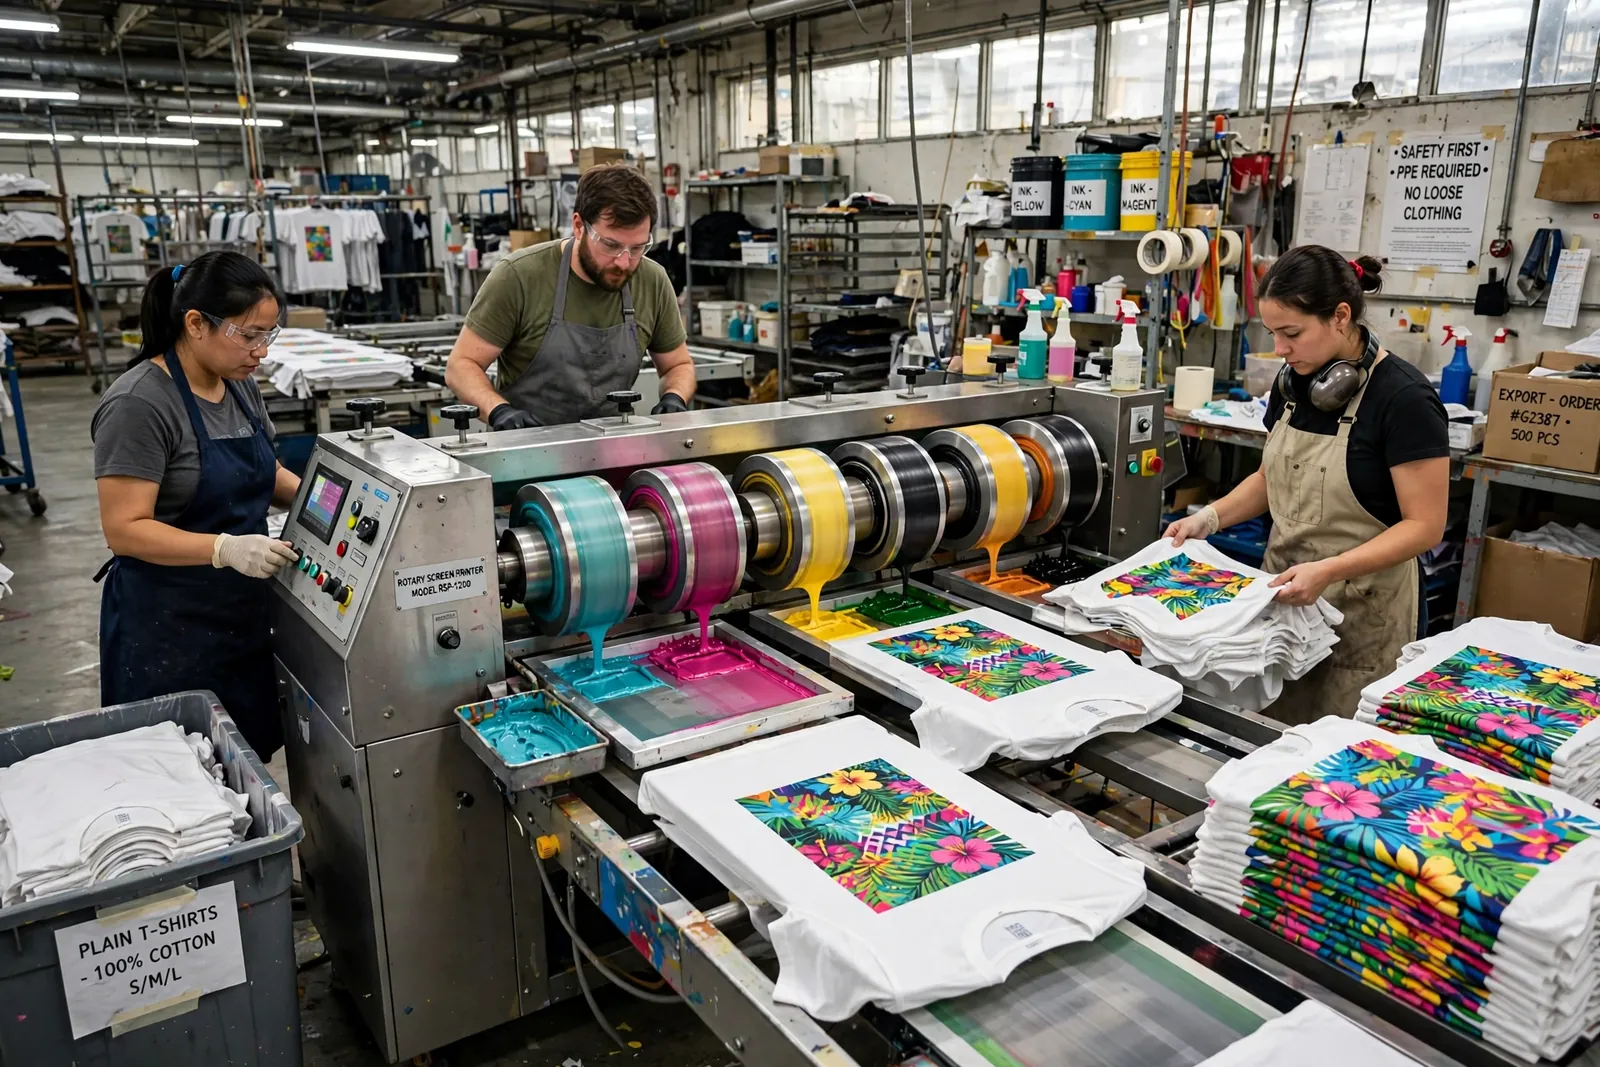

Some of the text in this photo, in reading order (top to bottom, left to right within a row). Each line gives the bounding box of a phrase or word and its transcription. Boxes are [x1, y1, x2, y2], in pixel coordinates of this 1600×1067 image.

[1401, 142, 1481, 159] SAFETY FIRST
[1397, 163, 1481, 179] PPE REQUIRED
[1018, 186, 1032, 196] INK
[1071, 185, 1085, 195] INK
[1130, 183, 1146, 194] INK
[1404, 185, 1463, 200] NO LOOSE
[1122, 199, 1157, 210] MAGENT
[1403, 206, 1462, 220] CLOTHING
[1498, 388, 1547, 405] EXPORT
[1559, 394, 1600, 411] ORDER
[1510, 409, 1561, 427] #G2387
[1511, 429, 1560, 446] 500 PCS
[397, 565, 484, 587] ROTARY SCREEN PRINTER
[411, 585, 437, 597] MODEL
[79, 905, 219, 959] PLAIN T-SHIRTS
[93, 953, 143, 981] 100%
[149, 930, 216, 963] COTTON
[129, 967, 182, 997] S/M/L
